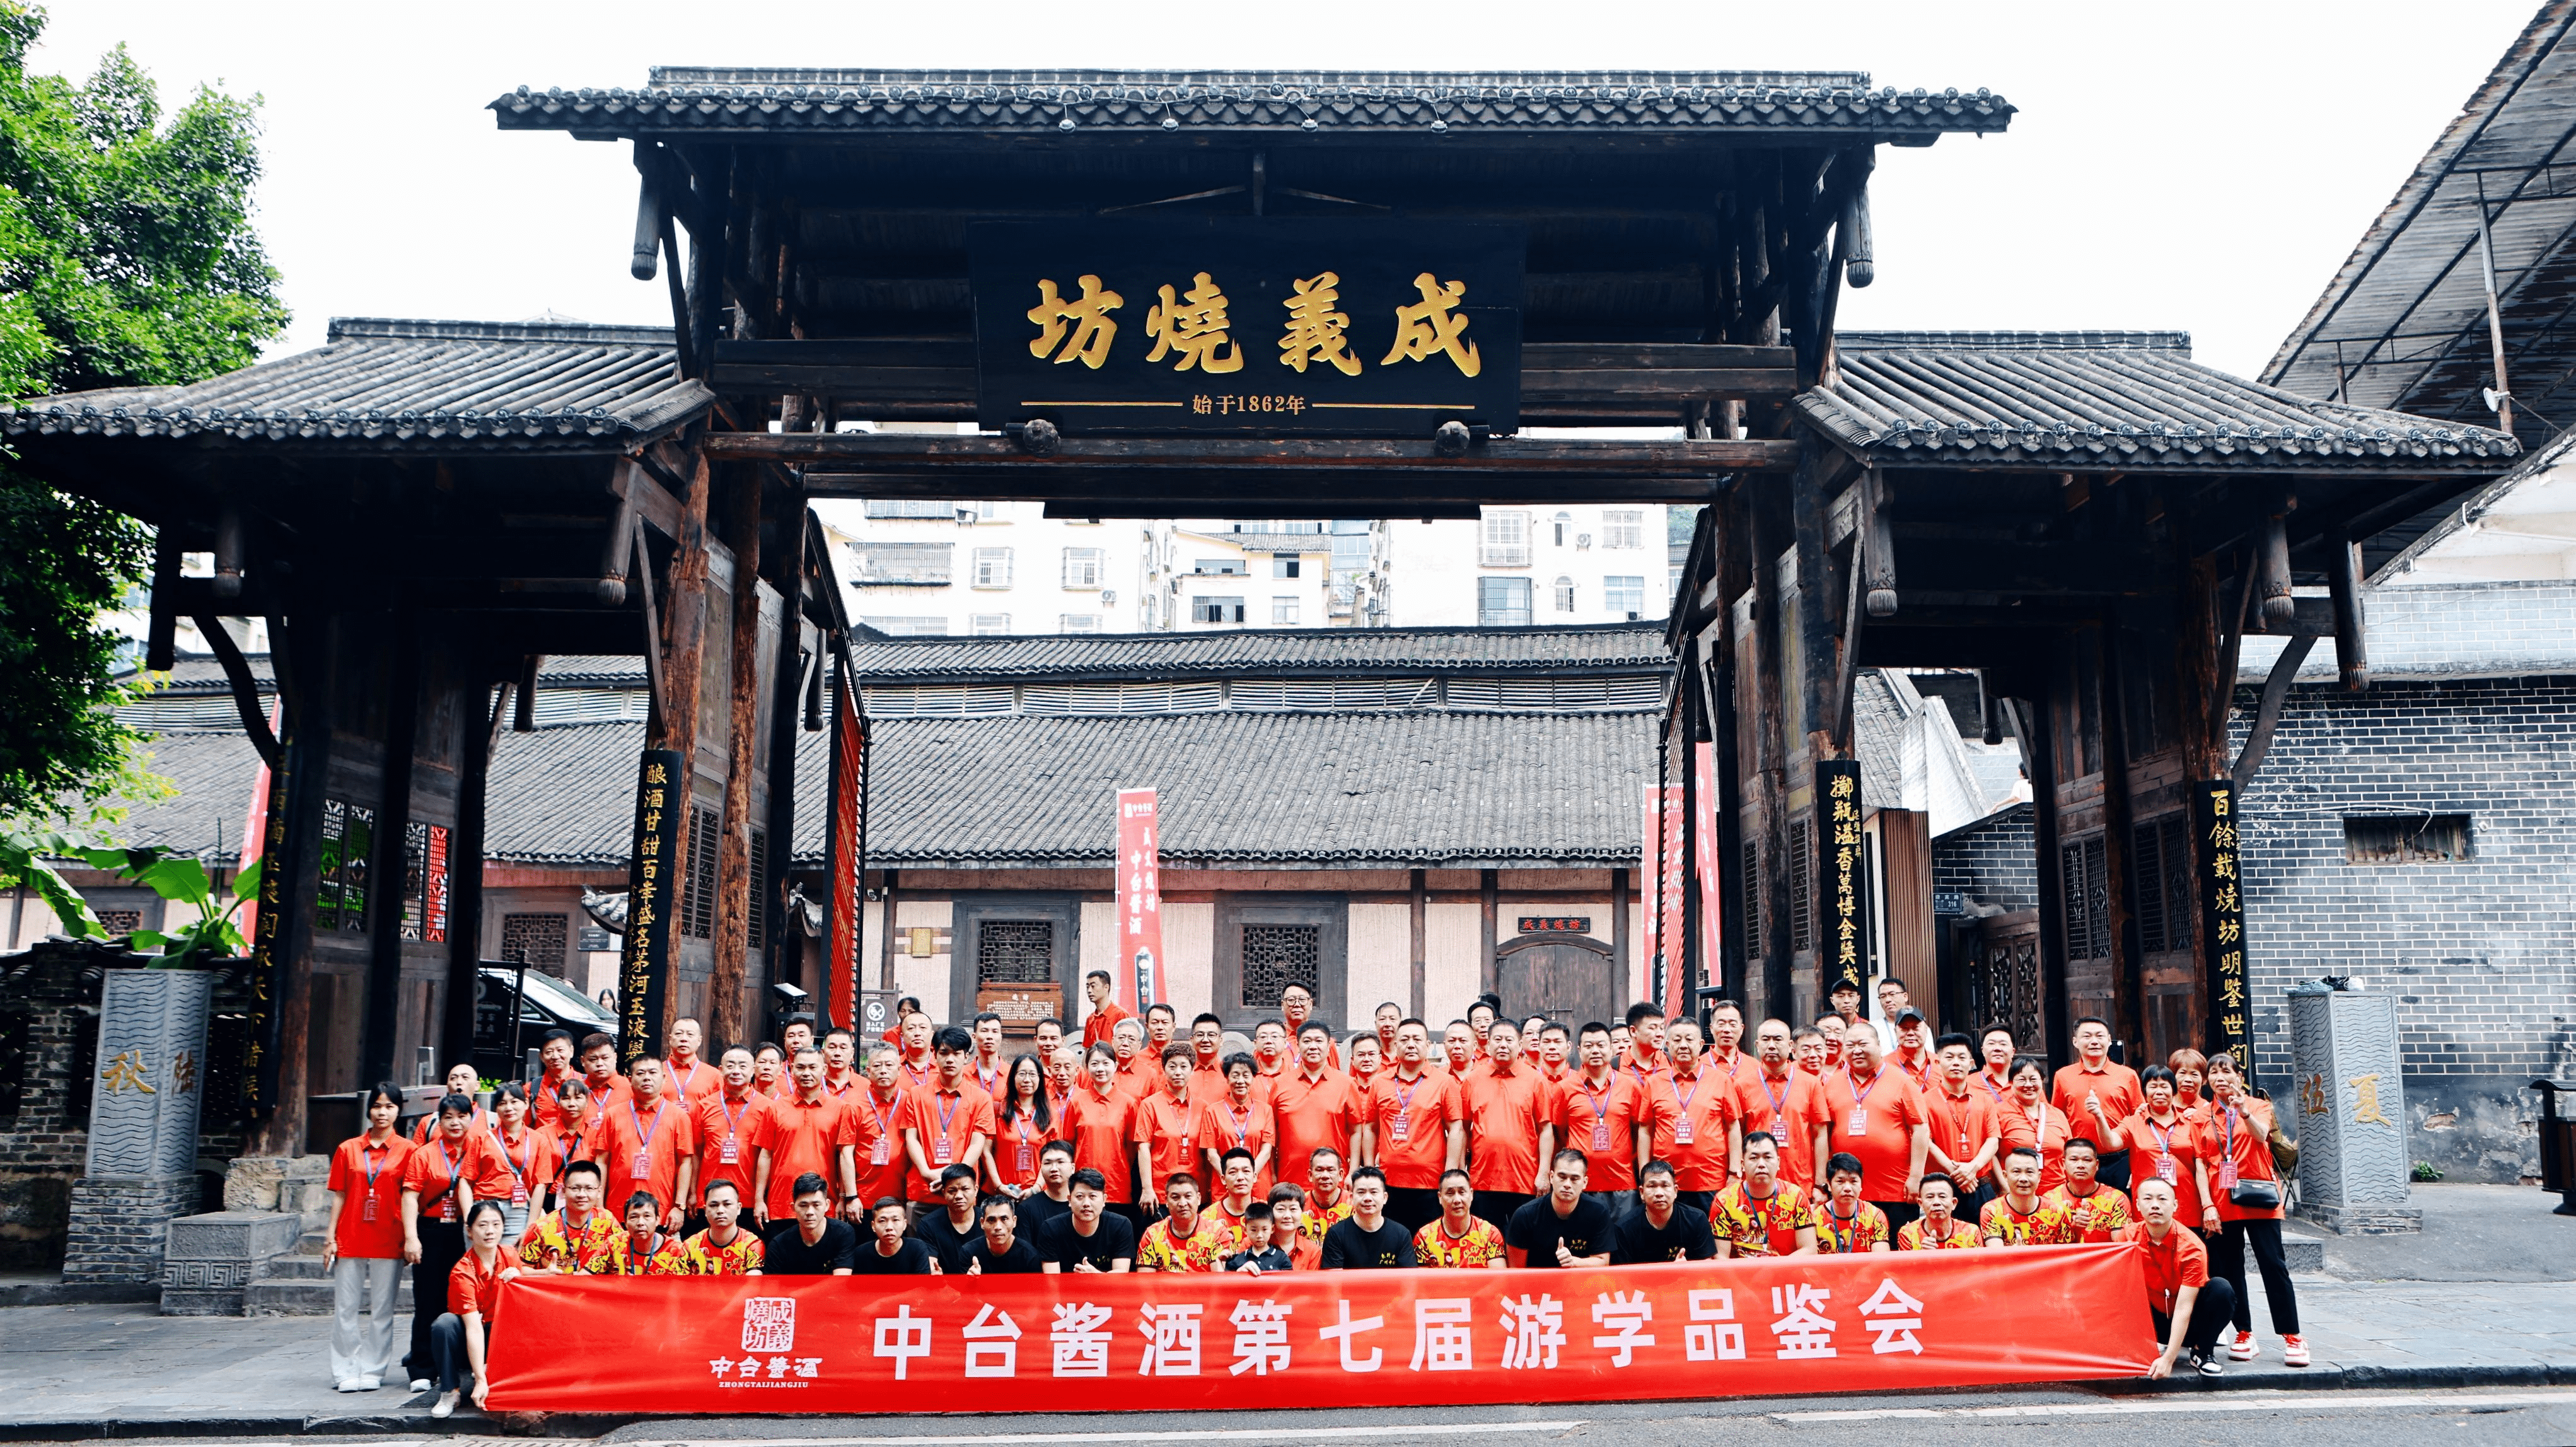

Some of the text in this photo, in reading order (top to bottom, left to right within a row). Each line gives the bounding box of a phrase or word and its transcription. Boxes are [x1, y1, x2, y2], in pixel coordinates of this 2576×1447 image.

[1192, 394, 1306, 416] 始于1862年
[101, 1049, 157, 1096] 秋
[2348, 1073, 2392, 1127] 夏
[874, 1278, 1925, 1381] 中台酱酒第七届游学品鉴会
